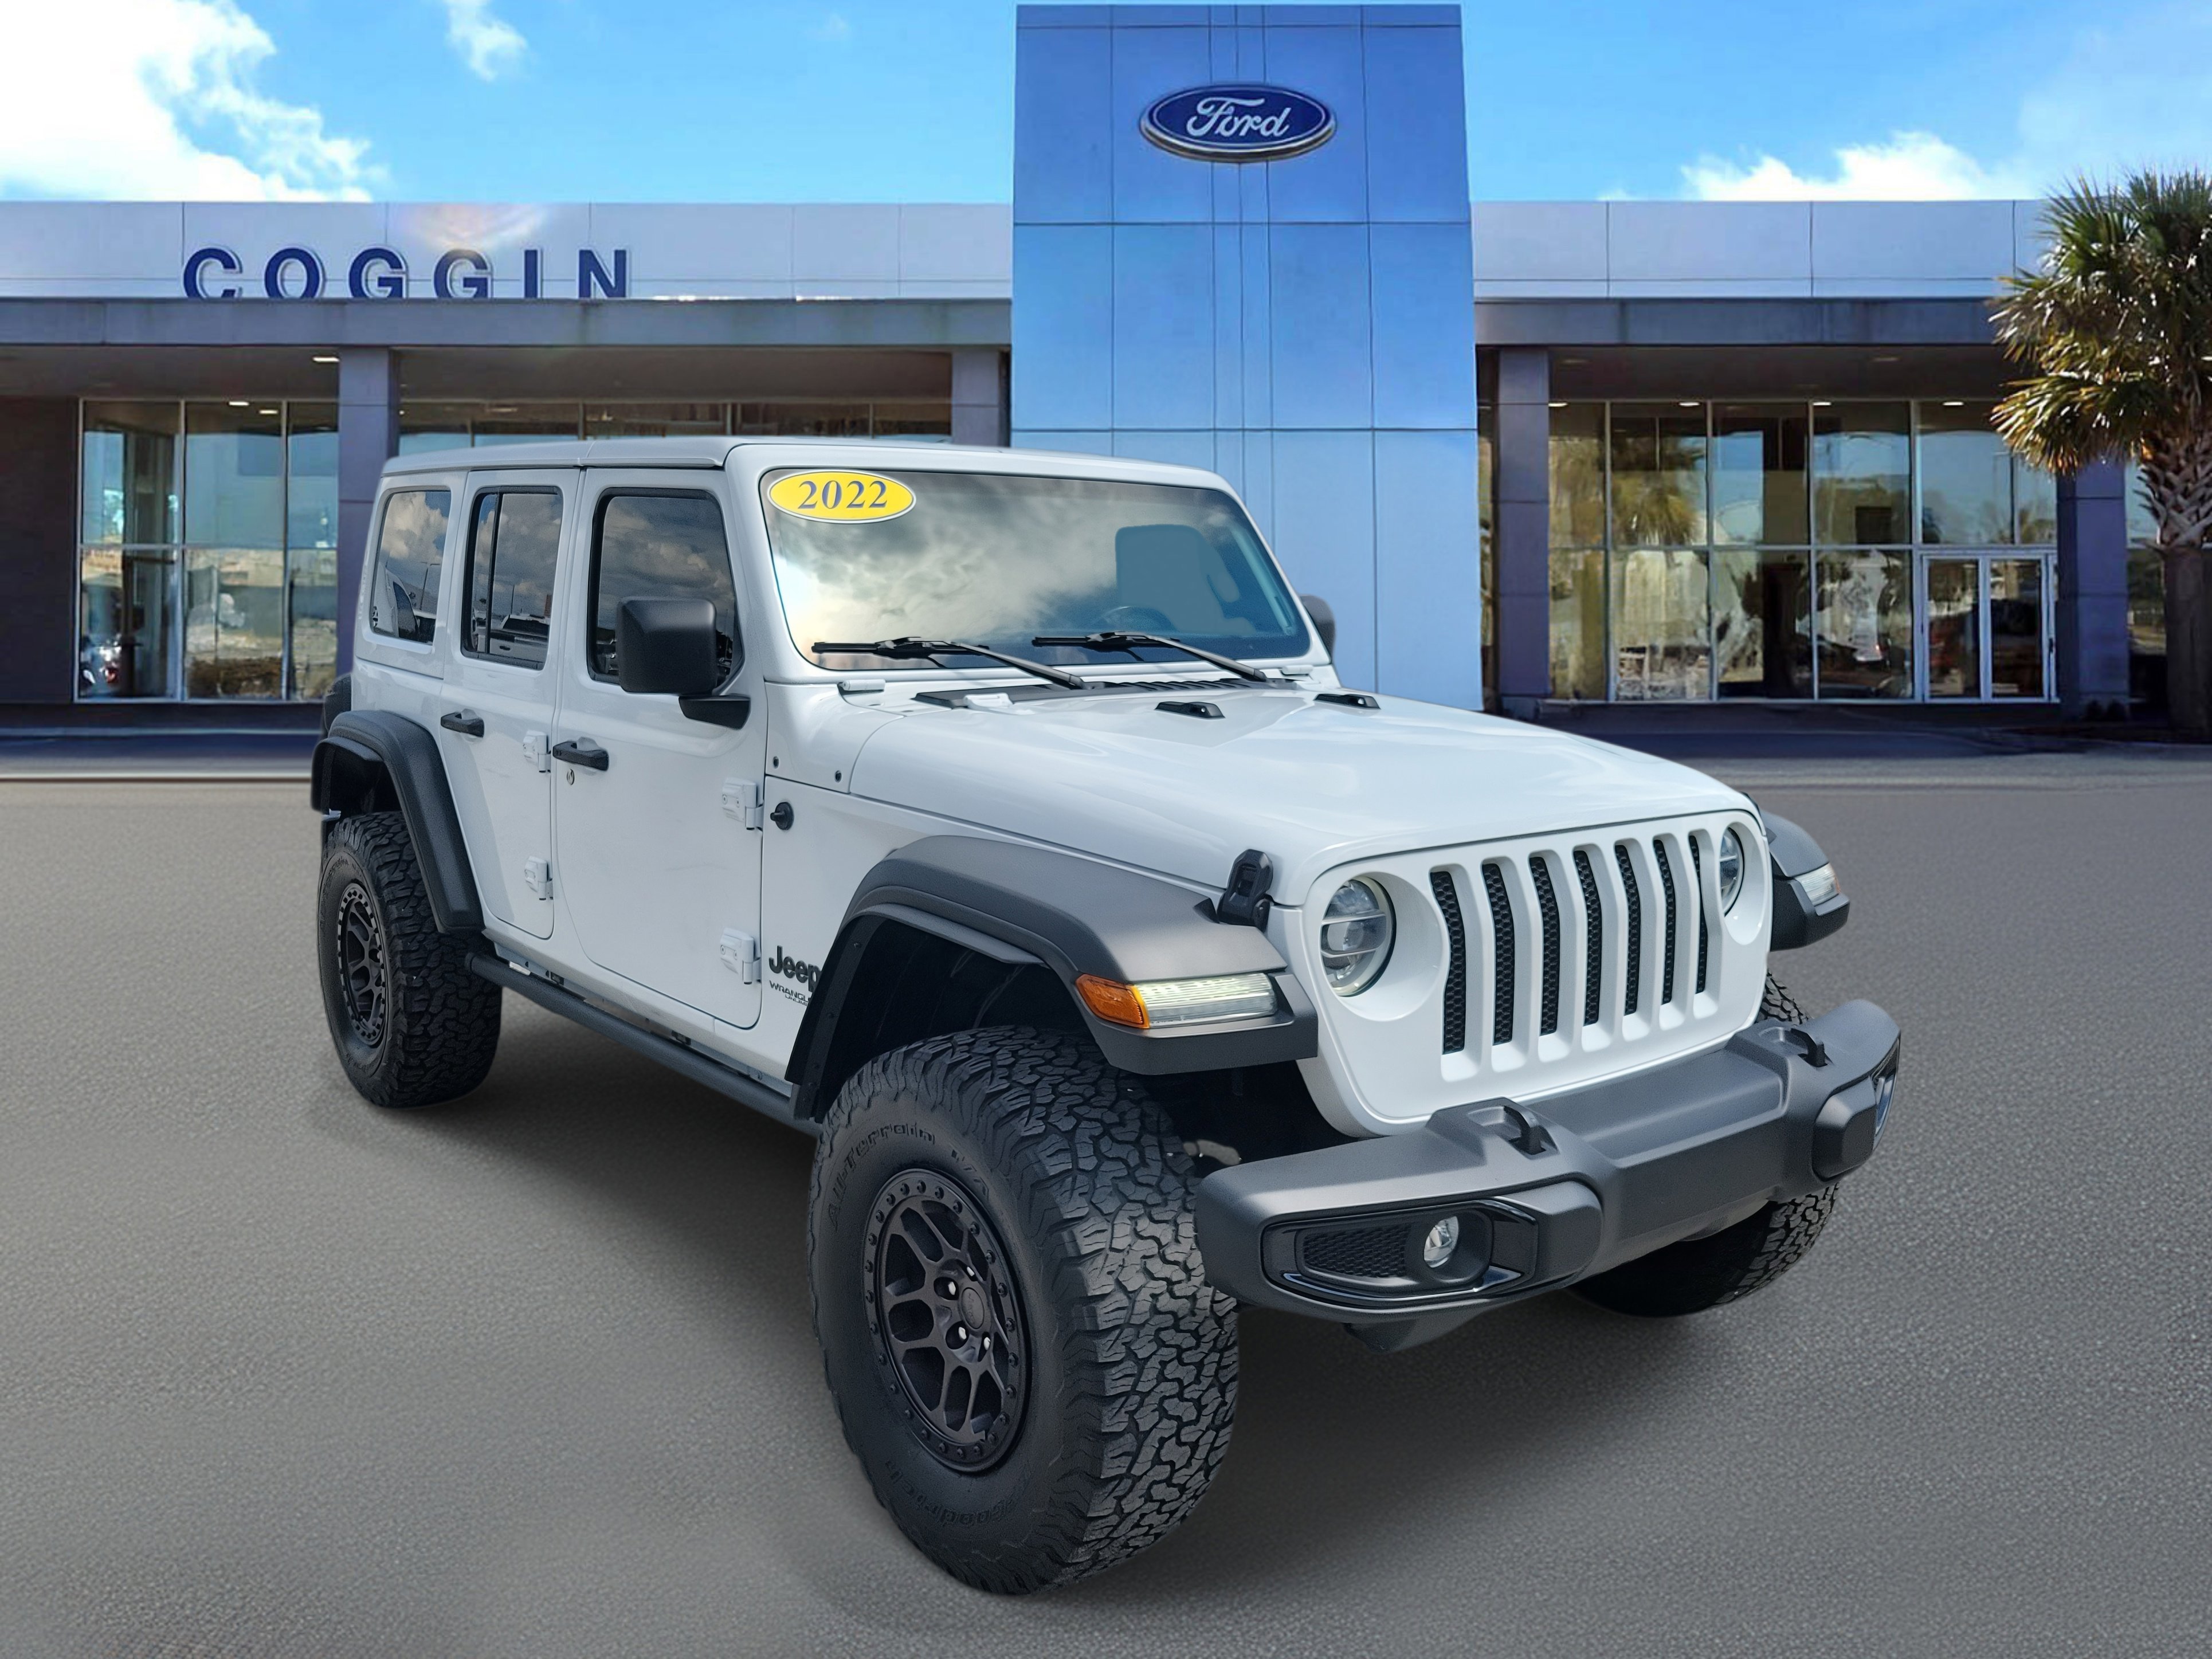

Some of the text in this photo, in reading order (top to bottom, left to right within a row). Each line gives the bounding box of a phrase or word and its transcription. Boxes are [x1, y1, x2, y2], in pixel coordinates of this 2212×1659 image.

[1186, 96, 1291, 136] Ford
[183, 247, 629, 299] COGGIN
[797, 480, 888, 509] 2022
[768, 945, 822, 993] Jeep
[768, 979, 811, 1003] WRANGL
